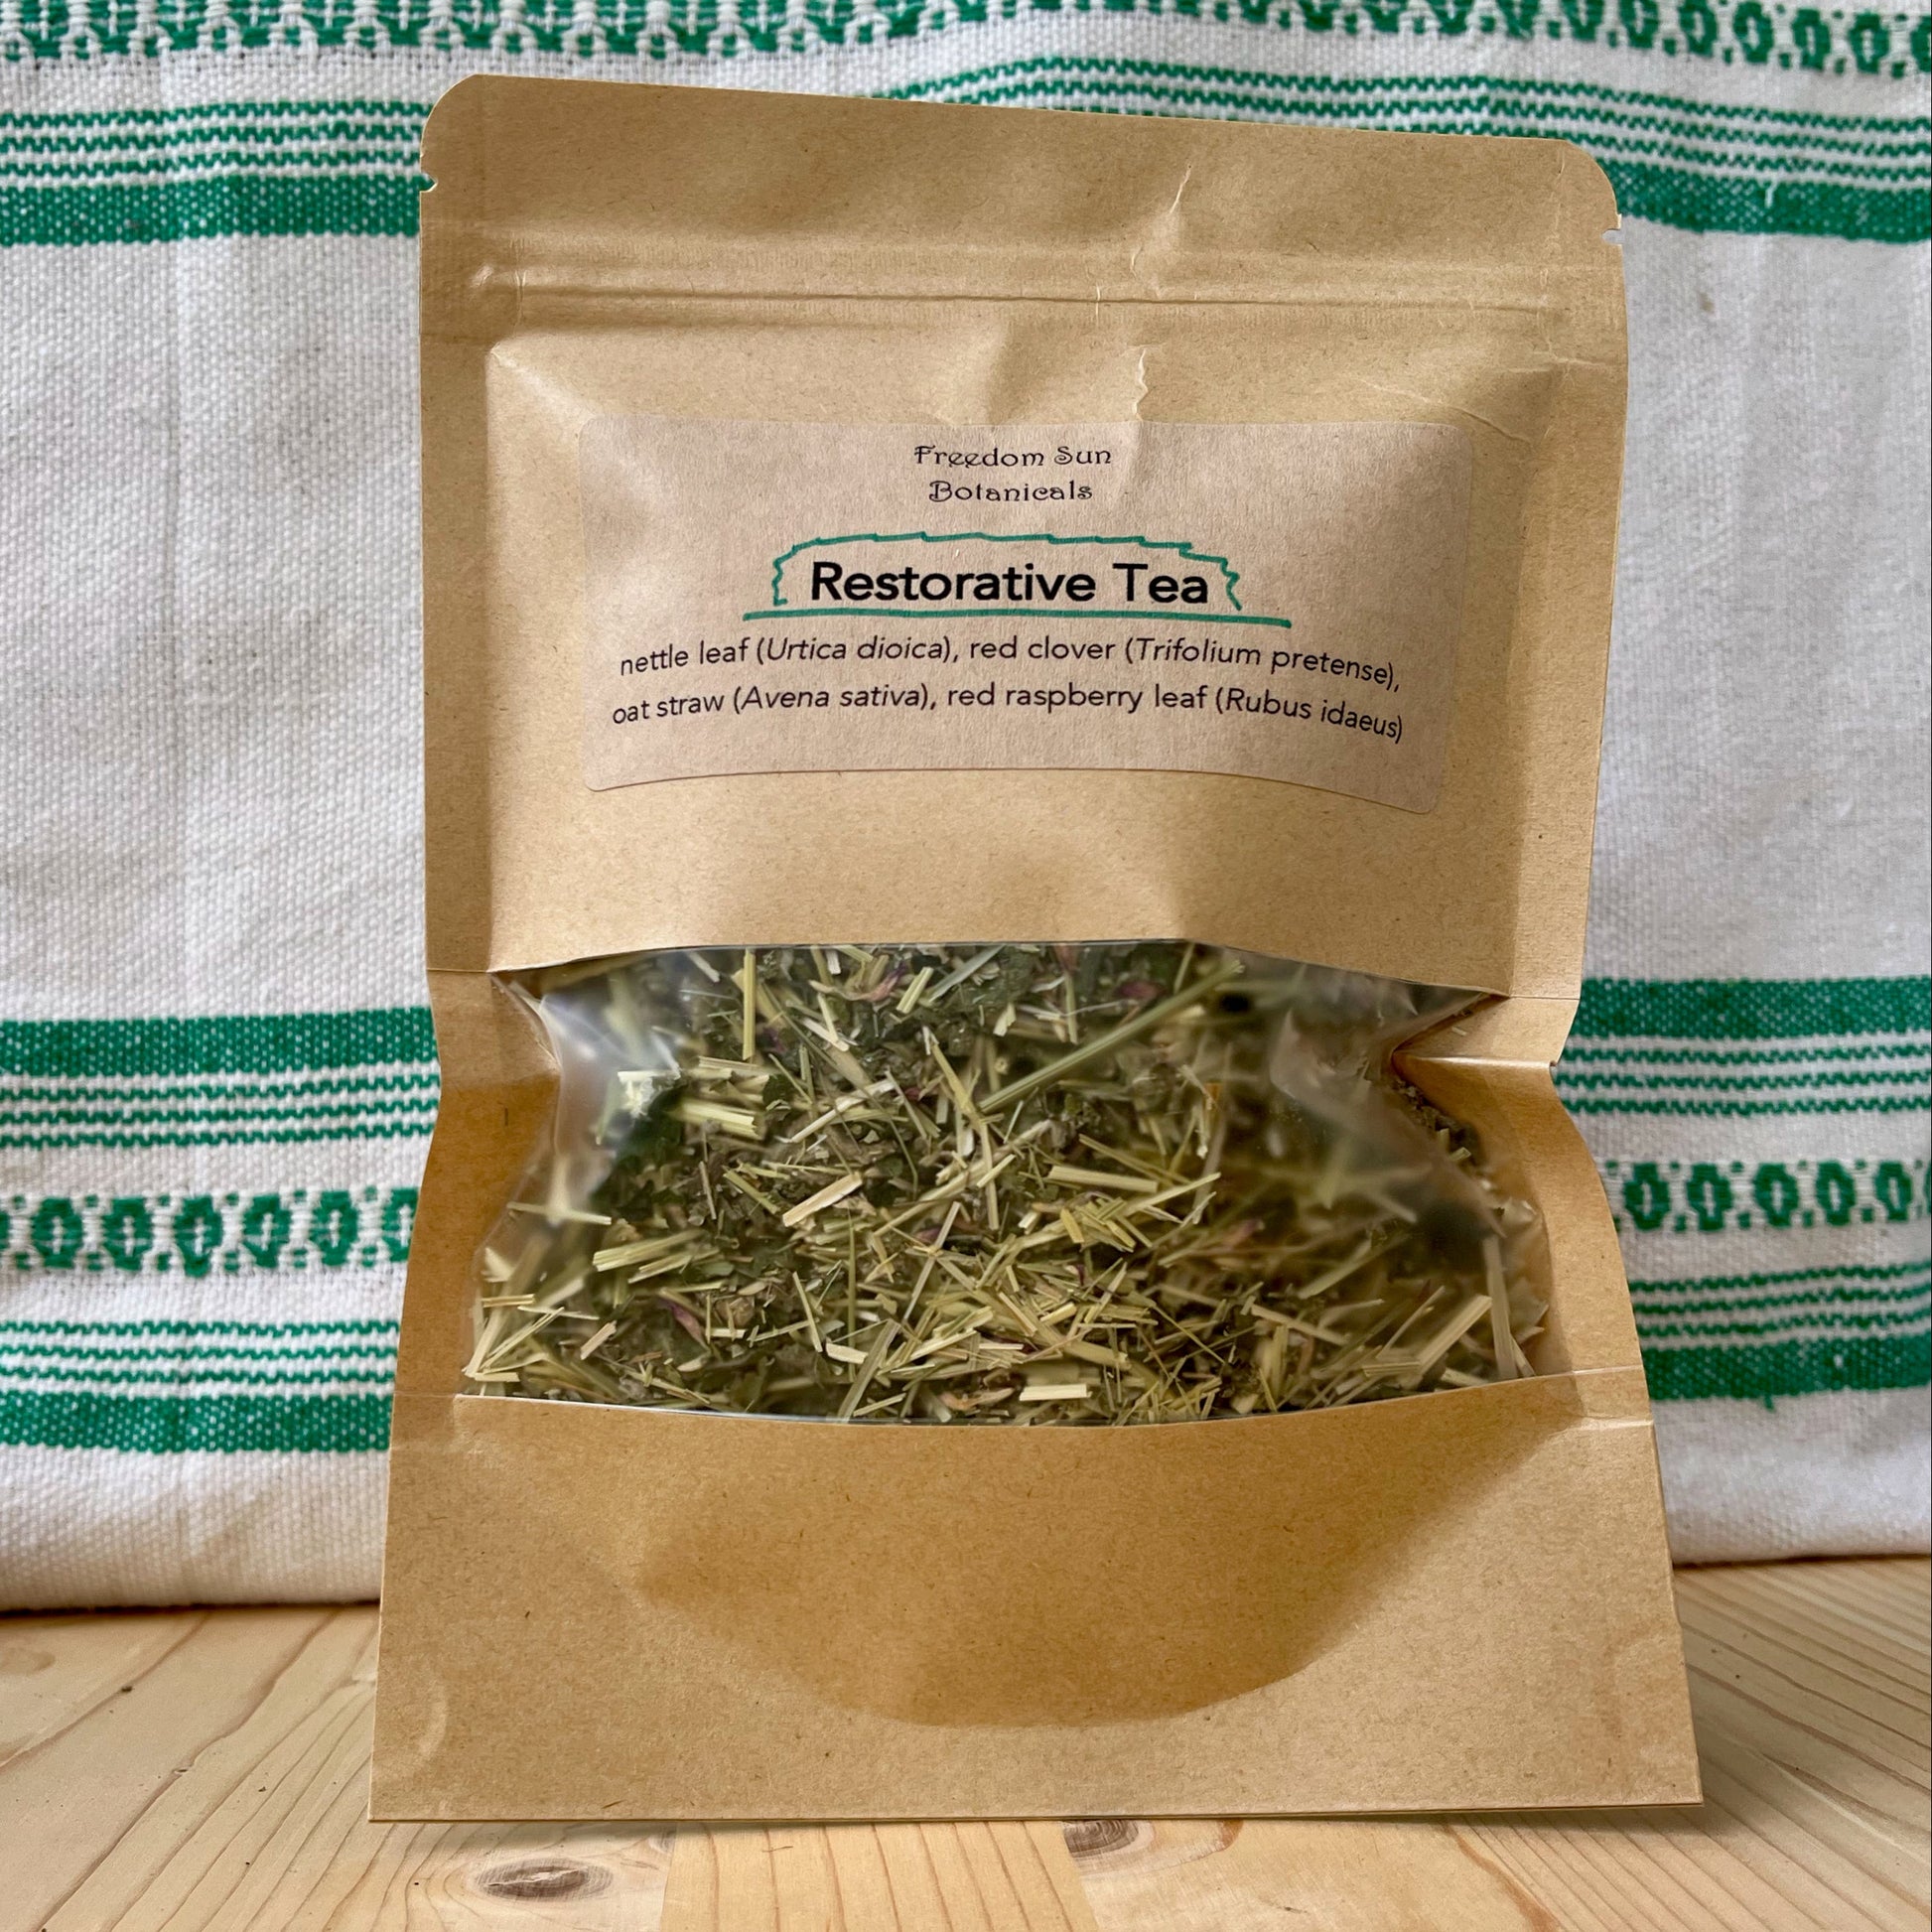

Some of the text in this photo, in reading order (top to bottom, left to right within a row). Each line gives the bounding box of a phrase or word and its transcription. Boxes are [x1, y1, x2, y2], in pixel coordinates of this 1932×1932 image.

[913, 444, 1112, 470] Freedom Sun
[928, 479, 1093, 503] Botanicals
[810, 560, 1209, 605] Restorative Tea
[621, 634, 1400, 693] nettle leaf (Urtica dioica), red clover (Trifolium pretense),
[612, 680, 1403, 745] oat straw (Avena sativa), red raspberry leaf (Rubus idaeus)
